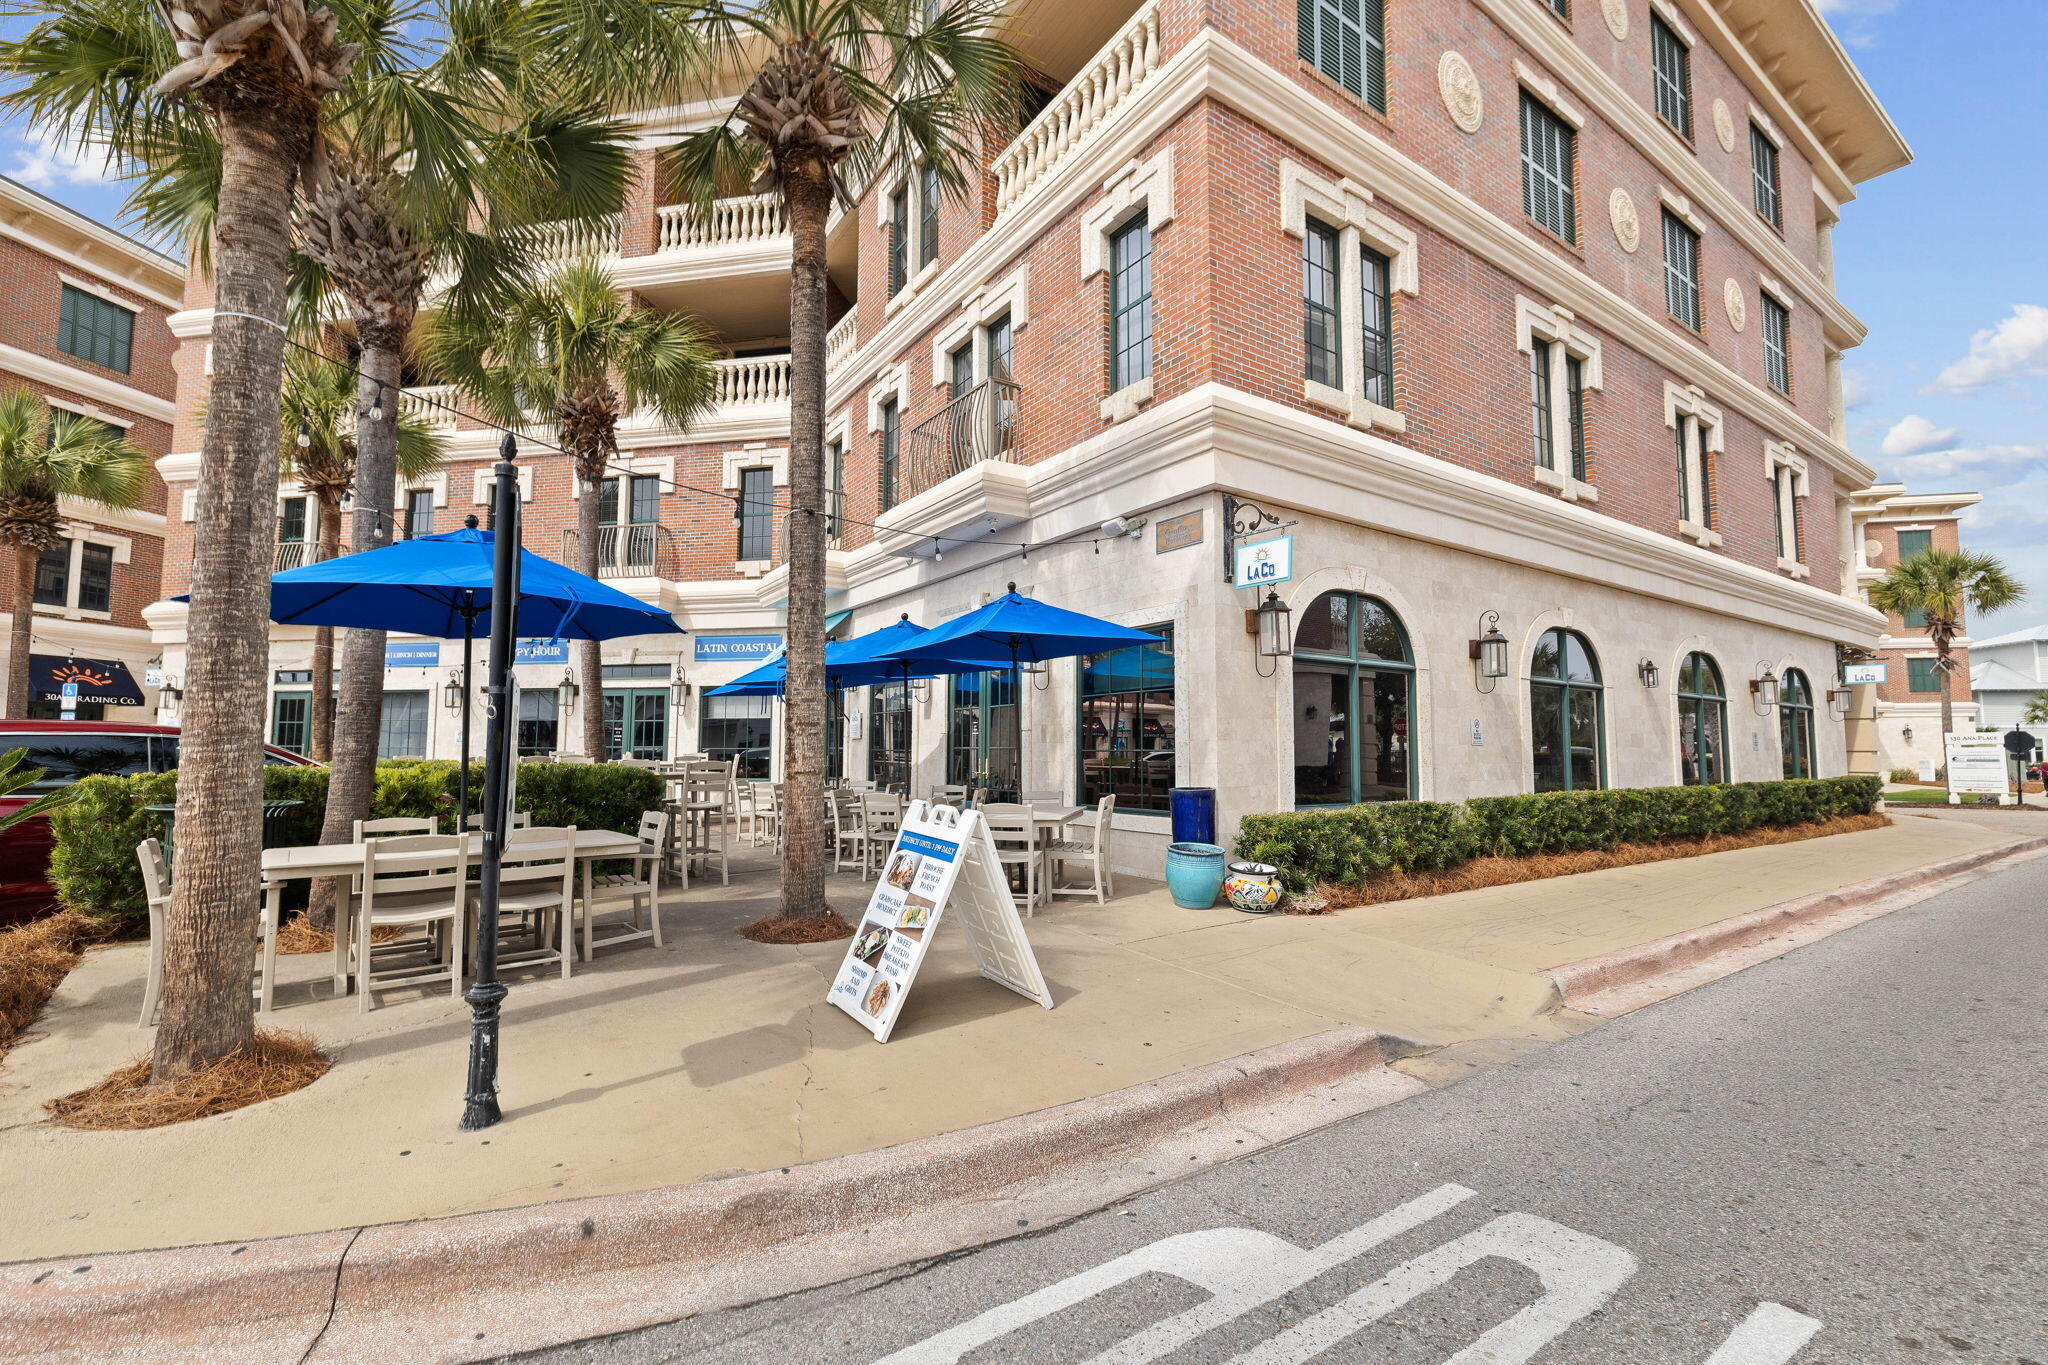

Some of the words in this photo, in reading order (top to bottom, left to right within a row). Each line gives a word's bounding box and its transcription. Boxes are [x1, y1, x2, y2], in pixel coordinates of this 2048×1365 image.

[533, 647, 561, 656] HOUR
[696, 644, 727, 653] LATIN
[731, 643, 777, 653] COASTAL
[44, 693, 62, 701] 30A
[77, 695, 118, 704] RADING
[934, 844, 942, 852] PM
[941, 845, 956, 855] DAILY
[924, 863, 945, 874] BRIOCHE
[921, 872, 941, 884] FRENCH
[920, 881, 936, 892] TOAST
[876, 902, 897, 916] BENEDICT
[897, 936, 912, 948] SWEET
[891, 945, 909, 959] POTATO
[883, 952, 909, 971] BREAKFAST
[851, 965, 868, 979] SHRIMP
[885, 965, 899, 977] HASH
[850, 976, 860, 986] AND
[845, 984, 857, 996] GRITS
